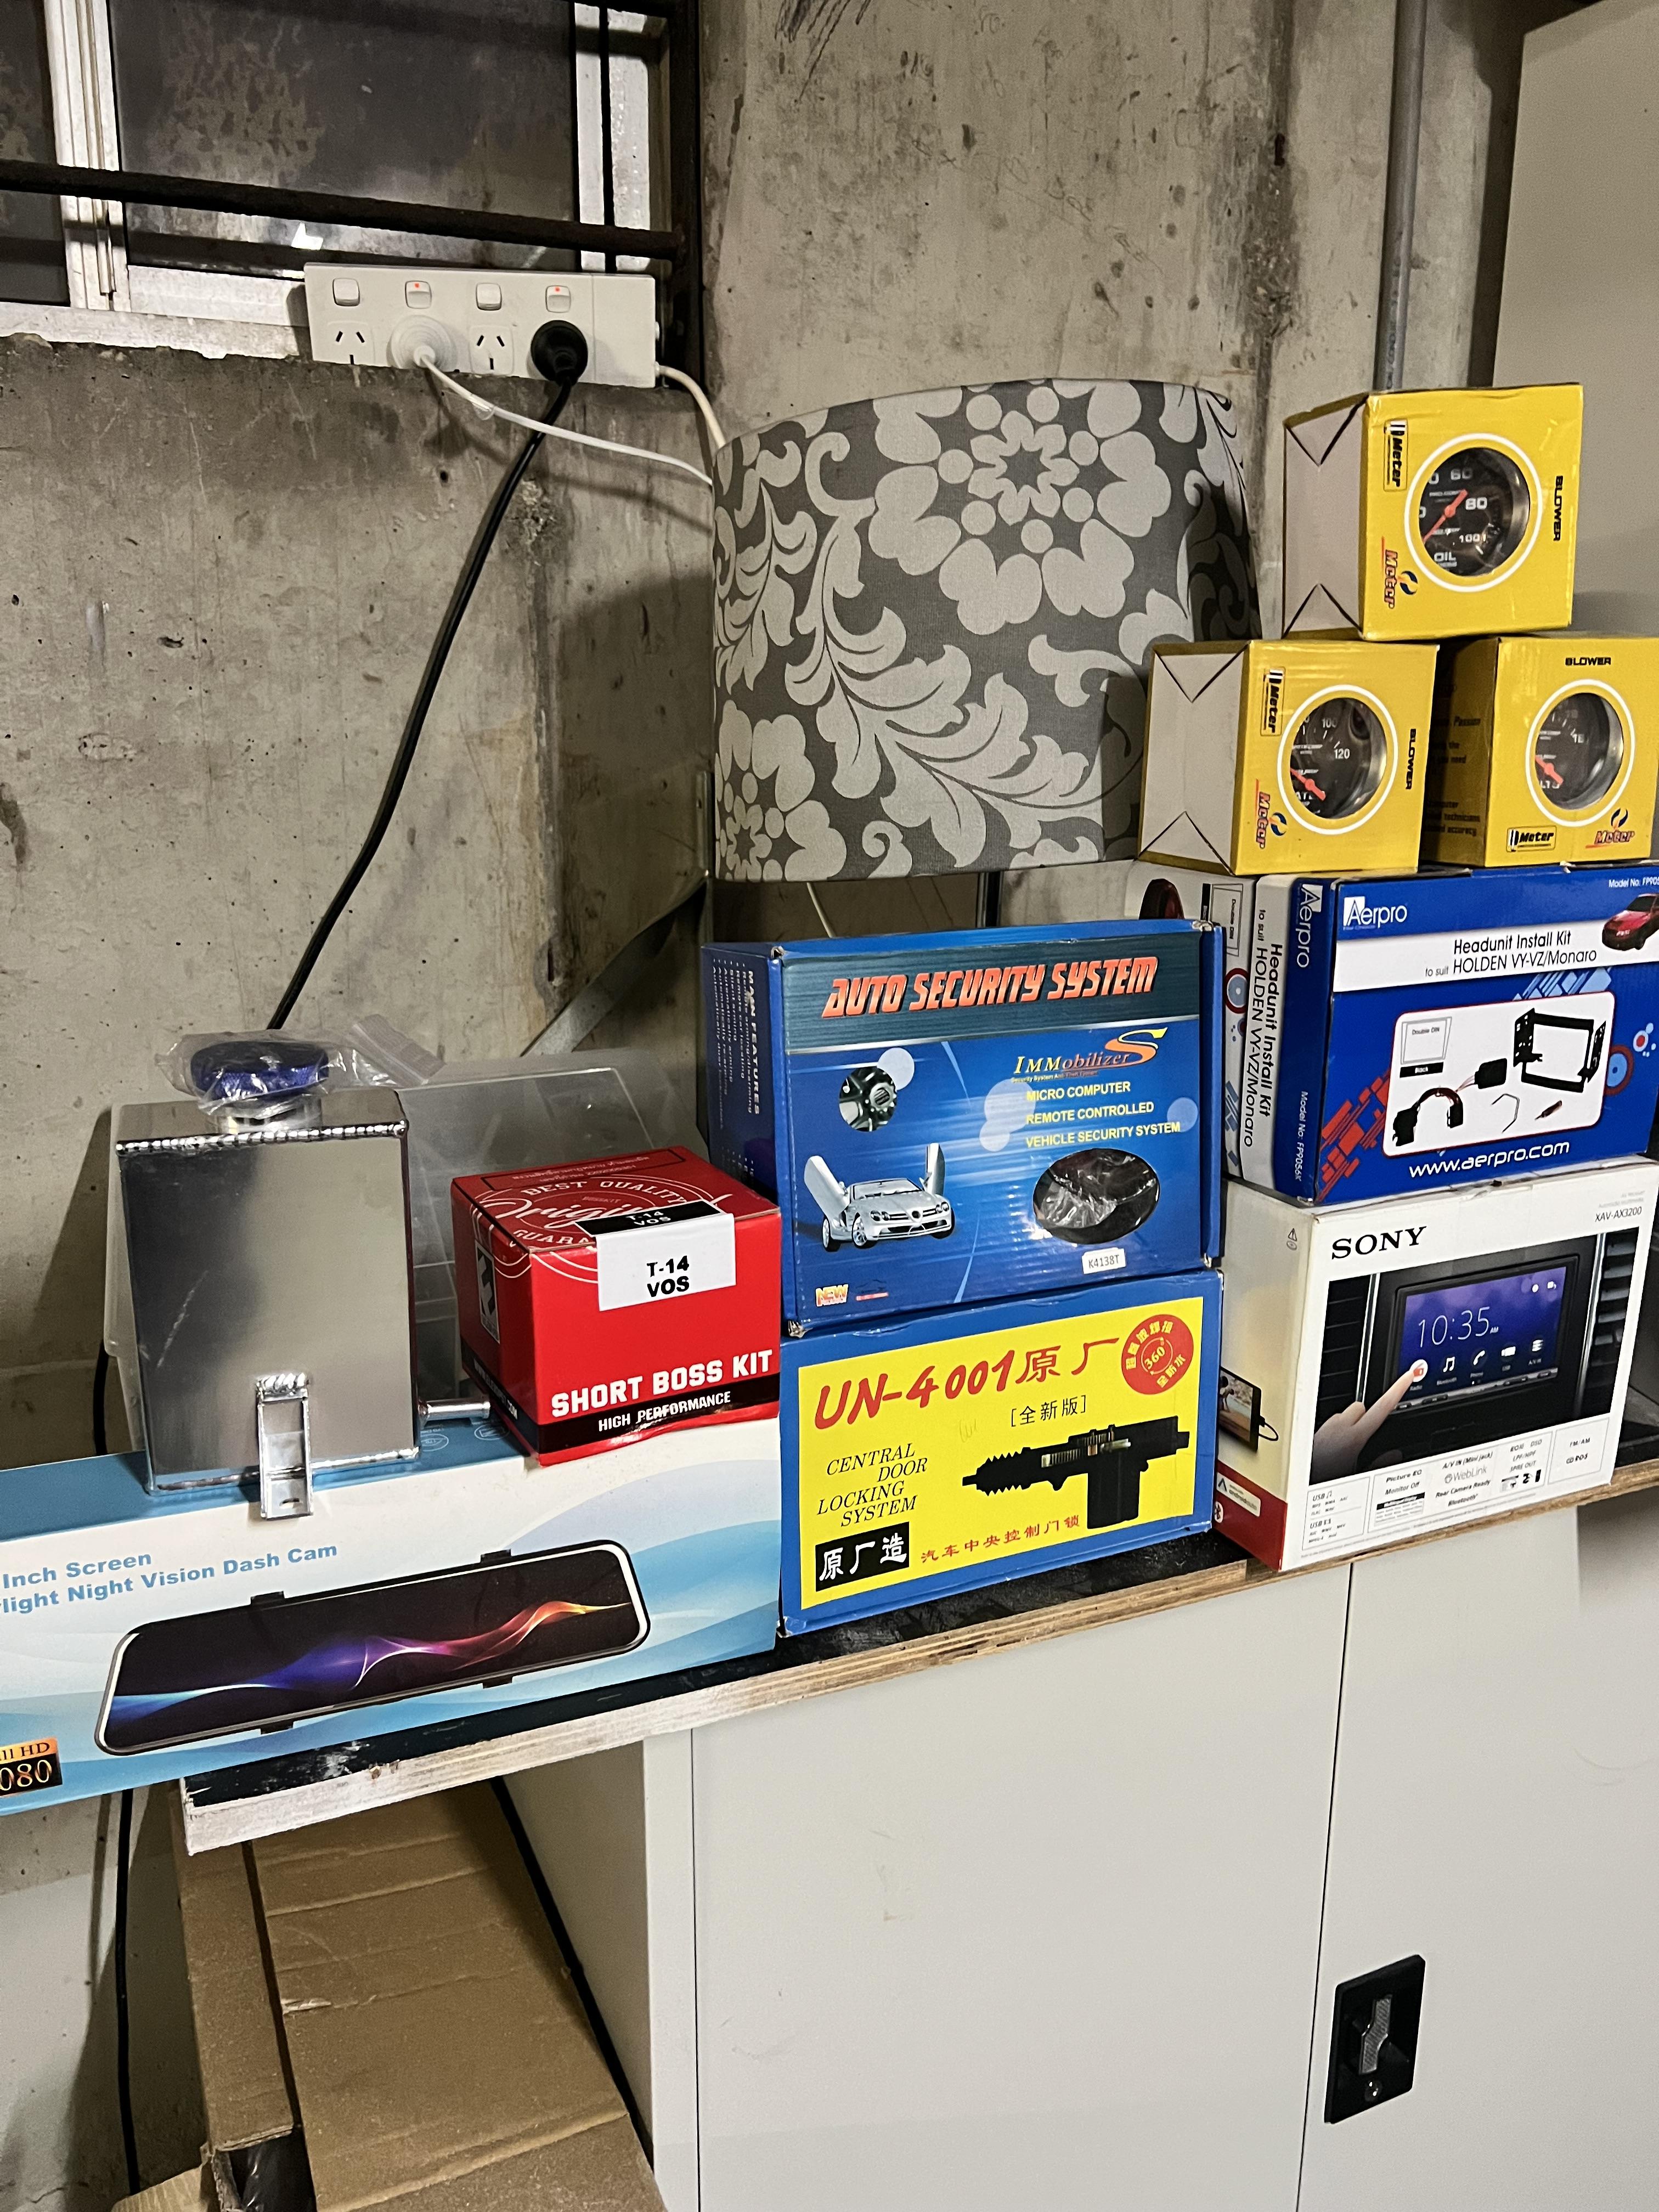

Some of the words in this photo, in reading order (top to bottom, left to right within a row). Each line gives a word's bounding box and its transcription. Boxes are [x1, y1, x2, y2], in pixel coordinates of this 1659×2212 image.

[1451, 467, 1472, 480] 60
[1465, 497, 1487, 510] 80
[1553, 475, 1563, 541] BLOWER
[1434, 552, 1456, 561] OIL
[1565, 657, 1611, 666] BLOWER
[1334, 748, 1350, 759] 120
[1406, 729, 1417, 790] BLOWER
[1609, 879, 1629, 888] Model
[1344, 896, 1407, 928] Aerpro
[1295, 883, 1323, 968] Aerpro
[1453, 935, 1513, 955] Headunit
[1517, 931, 1553, 950] Install
[1557, 930, 1571, 945] Kit
[1425, 967, 1434, 977] to
[1436, 964, 1449, 977] suit
[1454, 956, 1507, 974] HOLDEN
[821, 974, 909, 1019] AUTO
[910, 964, 1046, 1012] SECURITY
[1047, 956, 1159, 1001] SYSTEM
[1252, 947, 1268, 1022] HOLDEN
[1266, 943, 1283, 1030] Headunit
[751, 1022, 760, 1115] FEATURES
[1261, 1035, 1277, 1092] Install
[1026, 1088, 1065, 1102] MICRO
[1067, 1081, 1131, 1098] COMPUTER
[1026, 1110, 1075, 1125] REMOTE
[1077, 1102, 1155, 1120] CONTROLLED
[1259, 1096, 1272, 1117] Kit
[1299, 1091, 1308, 1122] Model
[1025, 1132, 1076, 1148] VEHICLE
[1077, 1126, 1134, 1143] SECURITY
[1136, 1122, 1181, 1137] SYSTEM
[1409, 1140, 1570, 1178] www.aerpro.com
[521, 1181, 588, 1196] BEST
[600, 1180, 688, 1204] QUALITY
[1594, 1206, 1642, 1222] XAV-AX3200
[1331, 1226, 1427, 1260] SONY
[646, 1255, 690, 1278] T-14
[647, 1276, 690, 1297] VOS
[816, 1284, 848, 1306] NEW
[1418, 1306, 1490, 1348] 10:35
[551, 1375, 643, 1419] SHORT
[652, 1359, 724, 1396] BOSS
[731, 1350, 773, 1379] KIT
[598, 1415, 631, 1433] HIGH
[635, 1391, 731, 1425] PERFORMANCE
[826, 1442, 916, 1476] CENTRAL
[877, 1457, 929, 1483] DOOR
[1453, 1464, 1488, 1482] WebLink
[817, 1480, 905, 1515] LOCKING
[1312, 1493, 1325, 1502] USB
[1385, 1485, 1409, 1496] Monitor
[1450, 1485, 1472, 1494] Camera
[840, 1495, 918, 1528] SYSTEM
[1310, 1520, 1323, 1530] USB
[2, 1567, 57, 1589] Inch
[66, 1552, 153, 1579] Screen
[819, 1532, 909, 1583] 原厂造
[0, 1591, 60, 1615] light
[67, 1579, 135, 1602] Night
[140, 1565, 216, 1589] Vision
[223, 1553, 281, 1576] Dash
[287, 1544, 339, 1565] Cam
[19, 1742, 50, 1757] HD
